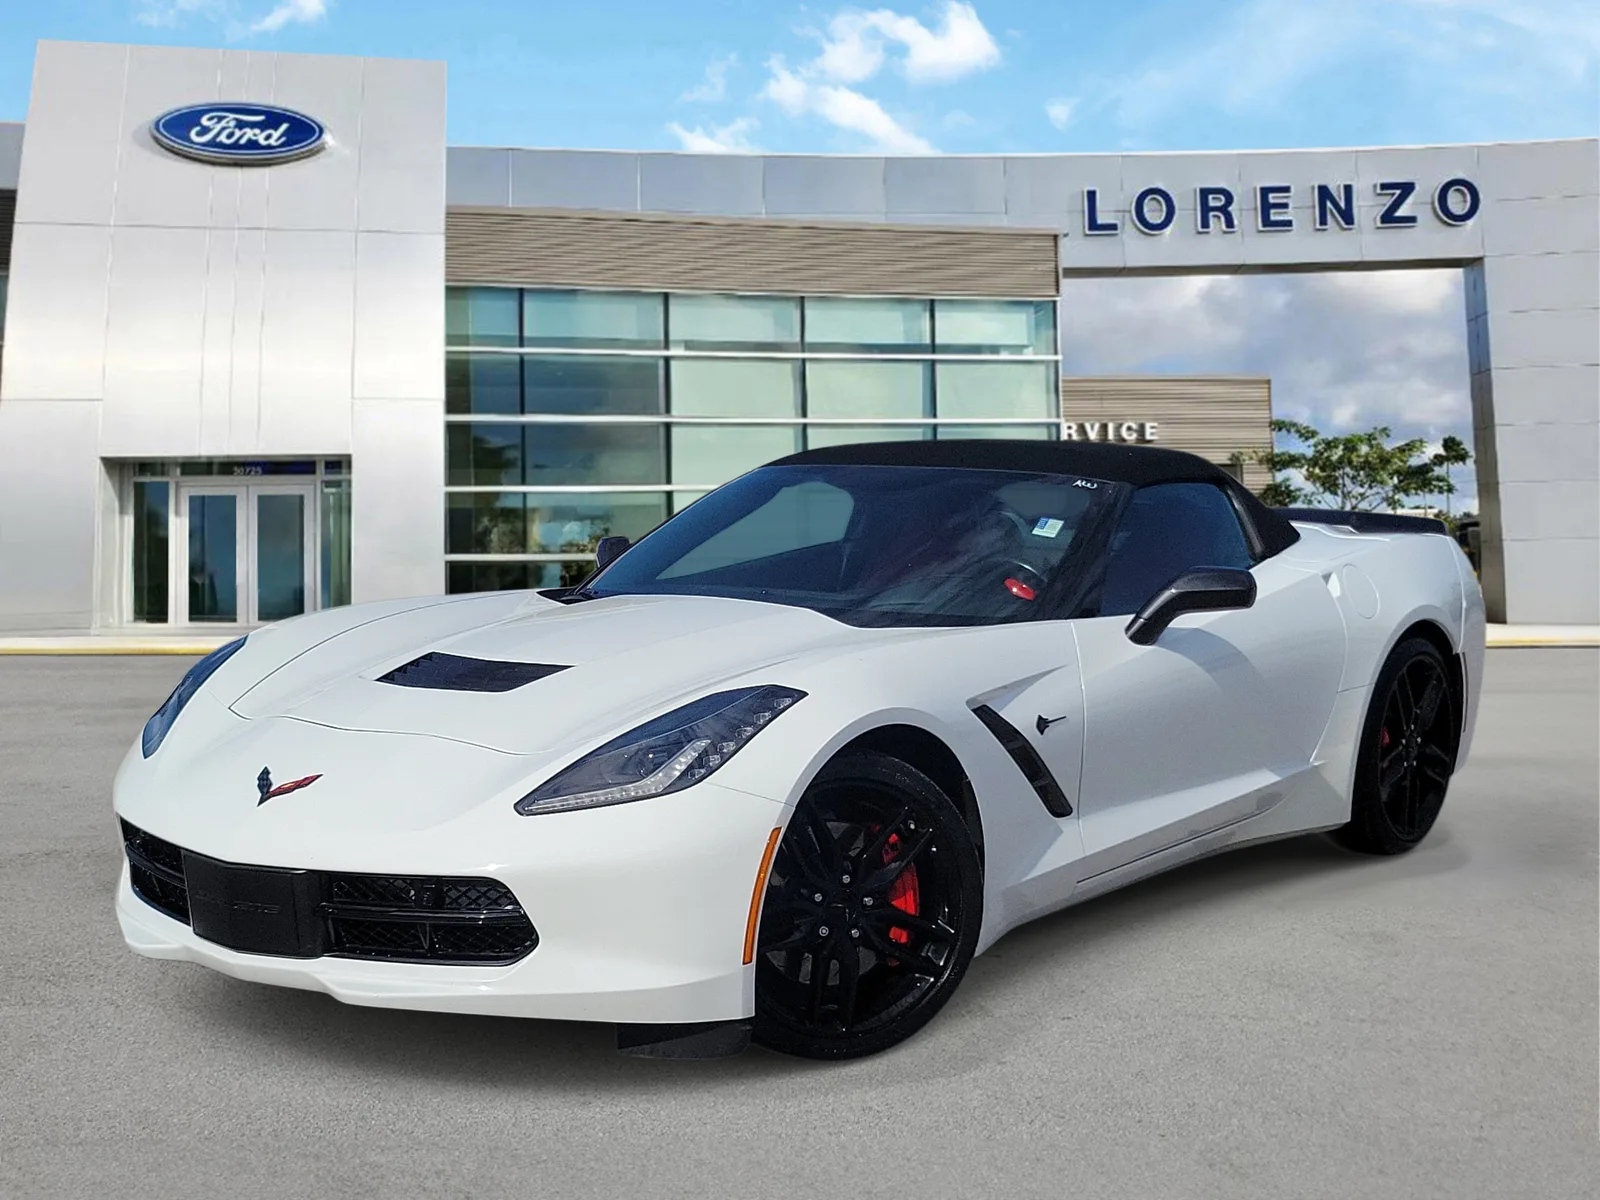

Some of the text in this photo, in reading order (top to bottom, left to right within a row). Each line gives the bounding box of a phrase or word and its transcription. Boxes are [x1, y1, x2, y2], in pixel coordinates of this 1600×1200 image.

[189, 111, 291, 147] Ford
[1083, 178, 1481, 236] LORENZO
[1063, 422, 1160, 441] RVICE
